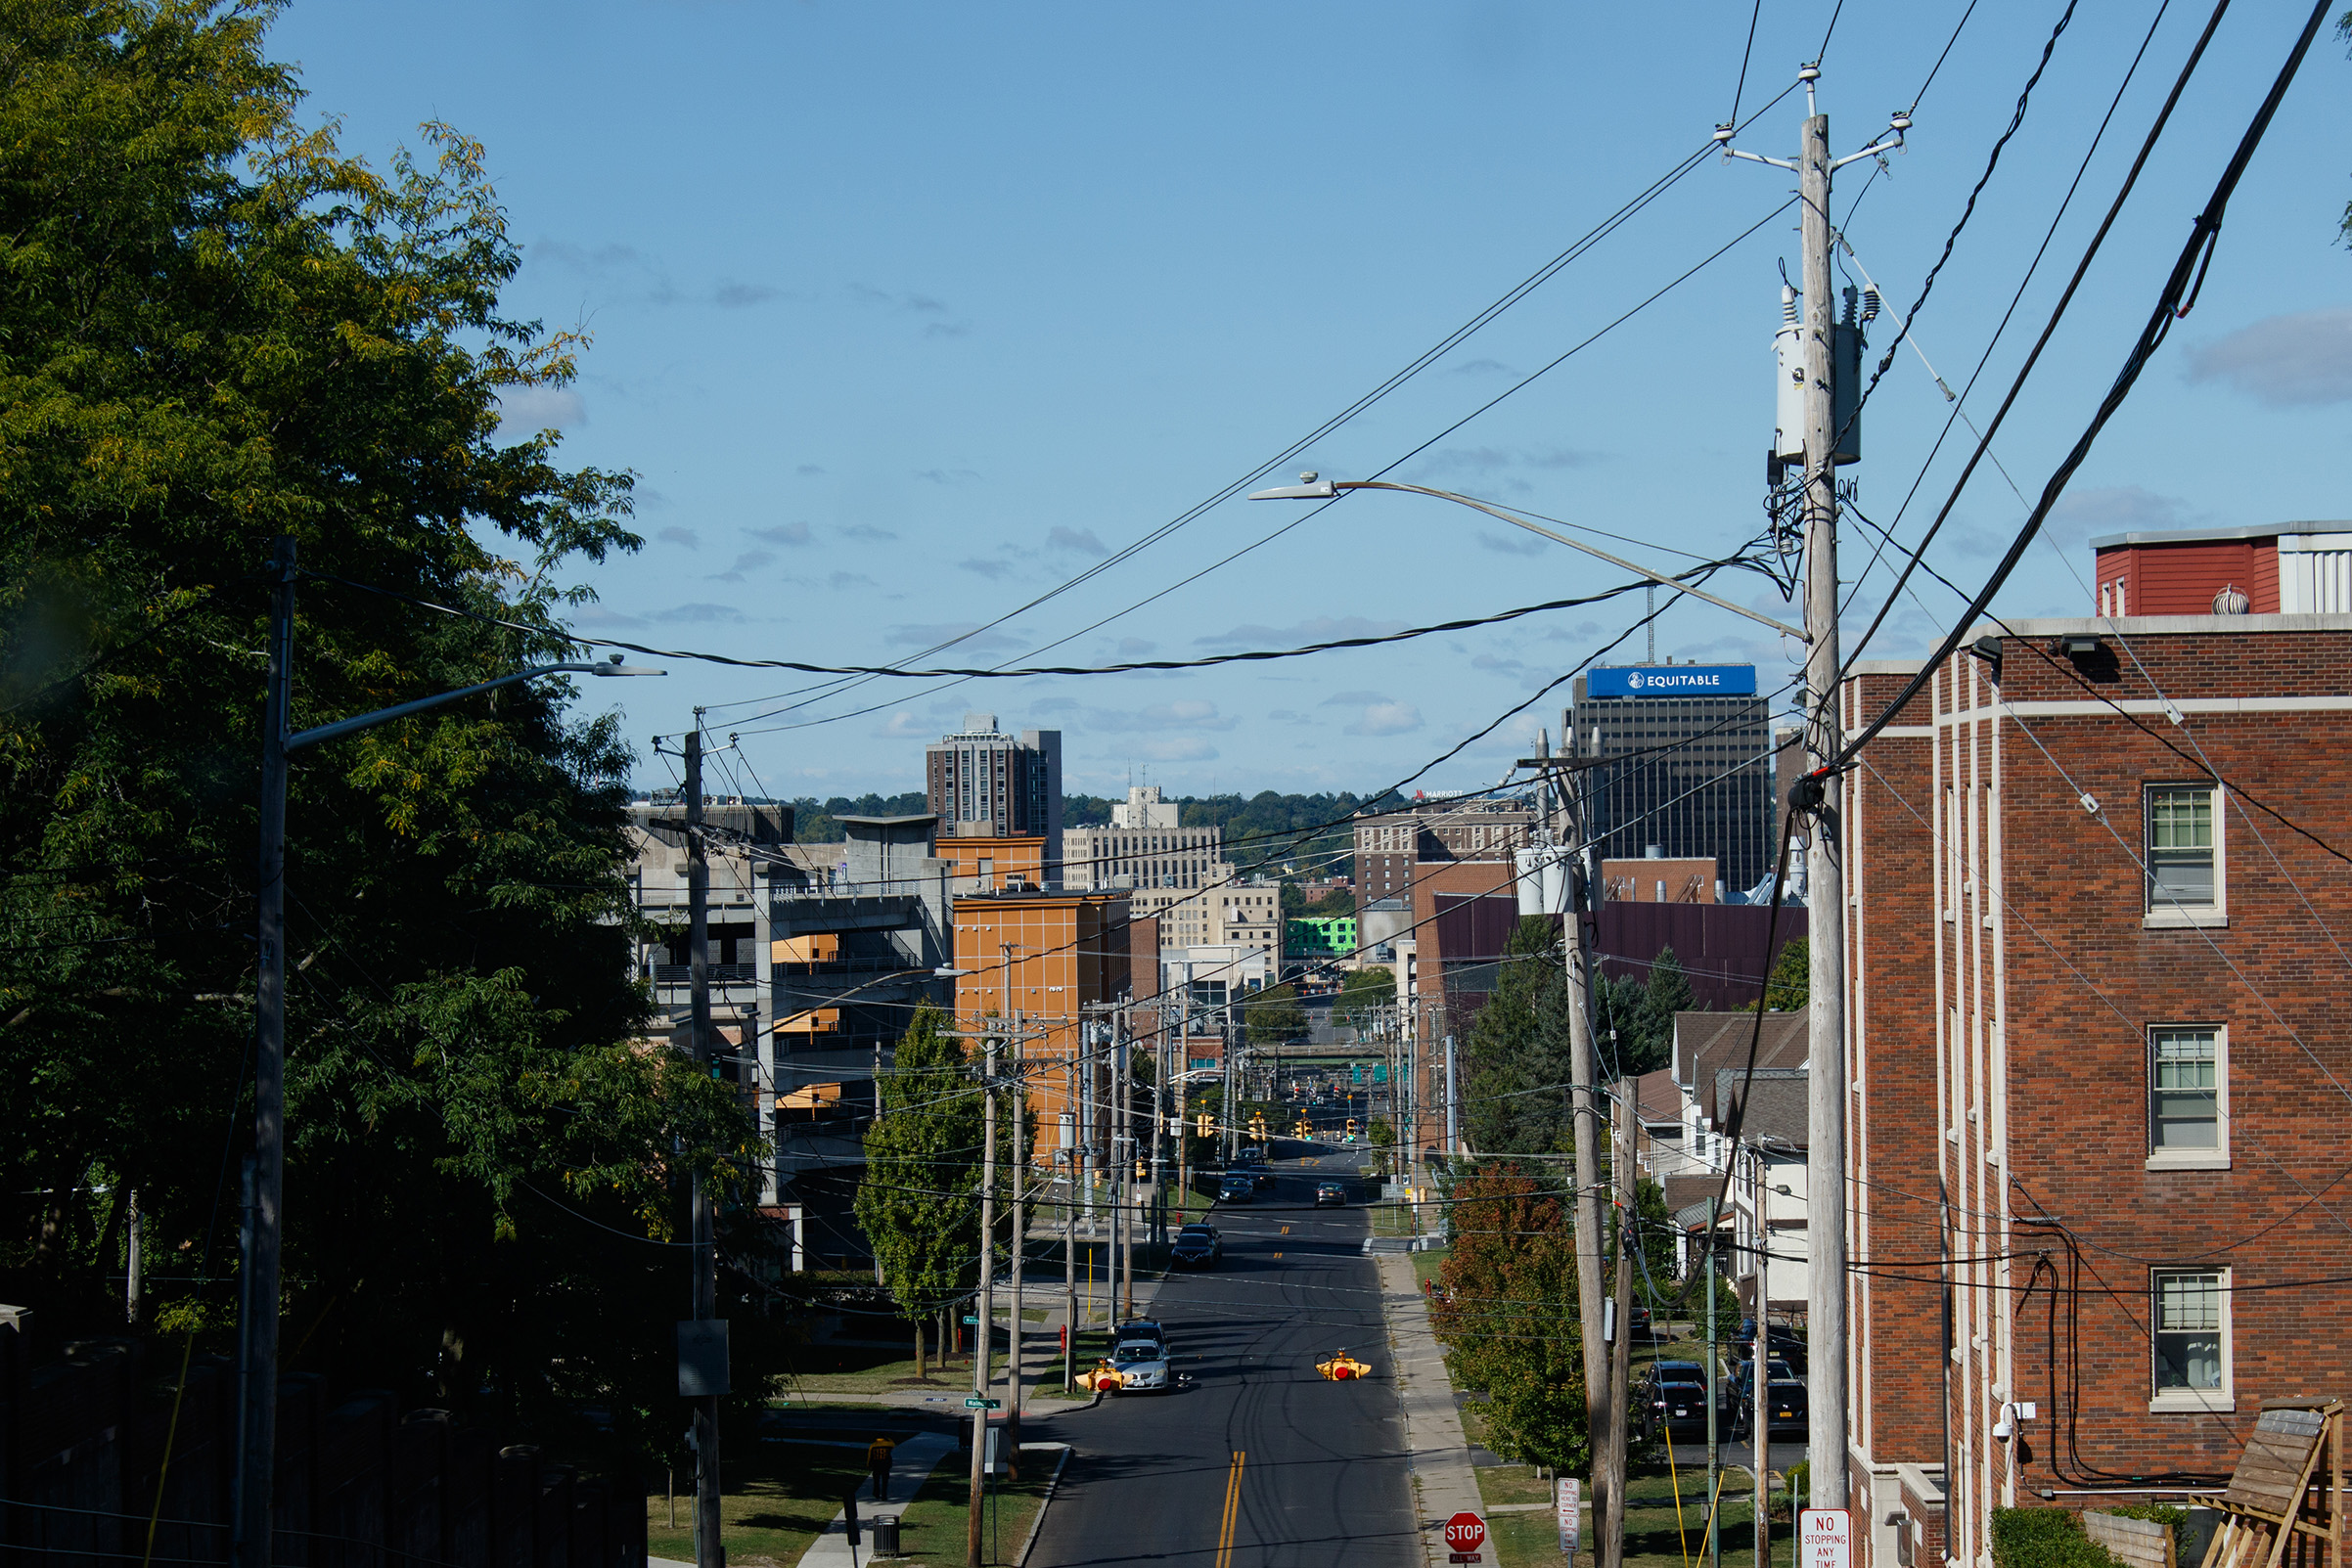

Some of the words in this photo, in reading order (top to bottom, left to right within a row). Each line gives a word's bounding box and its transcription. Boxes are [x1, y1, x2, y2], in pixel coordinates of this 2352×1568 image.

[1647, 675, 1720, 688] EQUITABLE
[1425, 790, 1464, 799] MARRIOTT
[1816, 1517, 1834, 1531] NO
[1447, 1525, 1483, 1541] STOP
[1804, 1535, 1846, 1545] STOPPING
[1817, 1547, 1834, 1557] ANY
[1466, 1554, 1480, 1563] WAY
